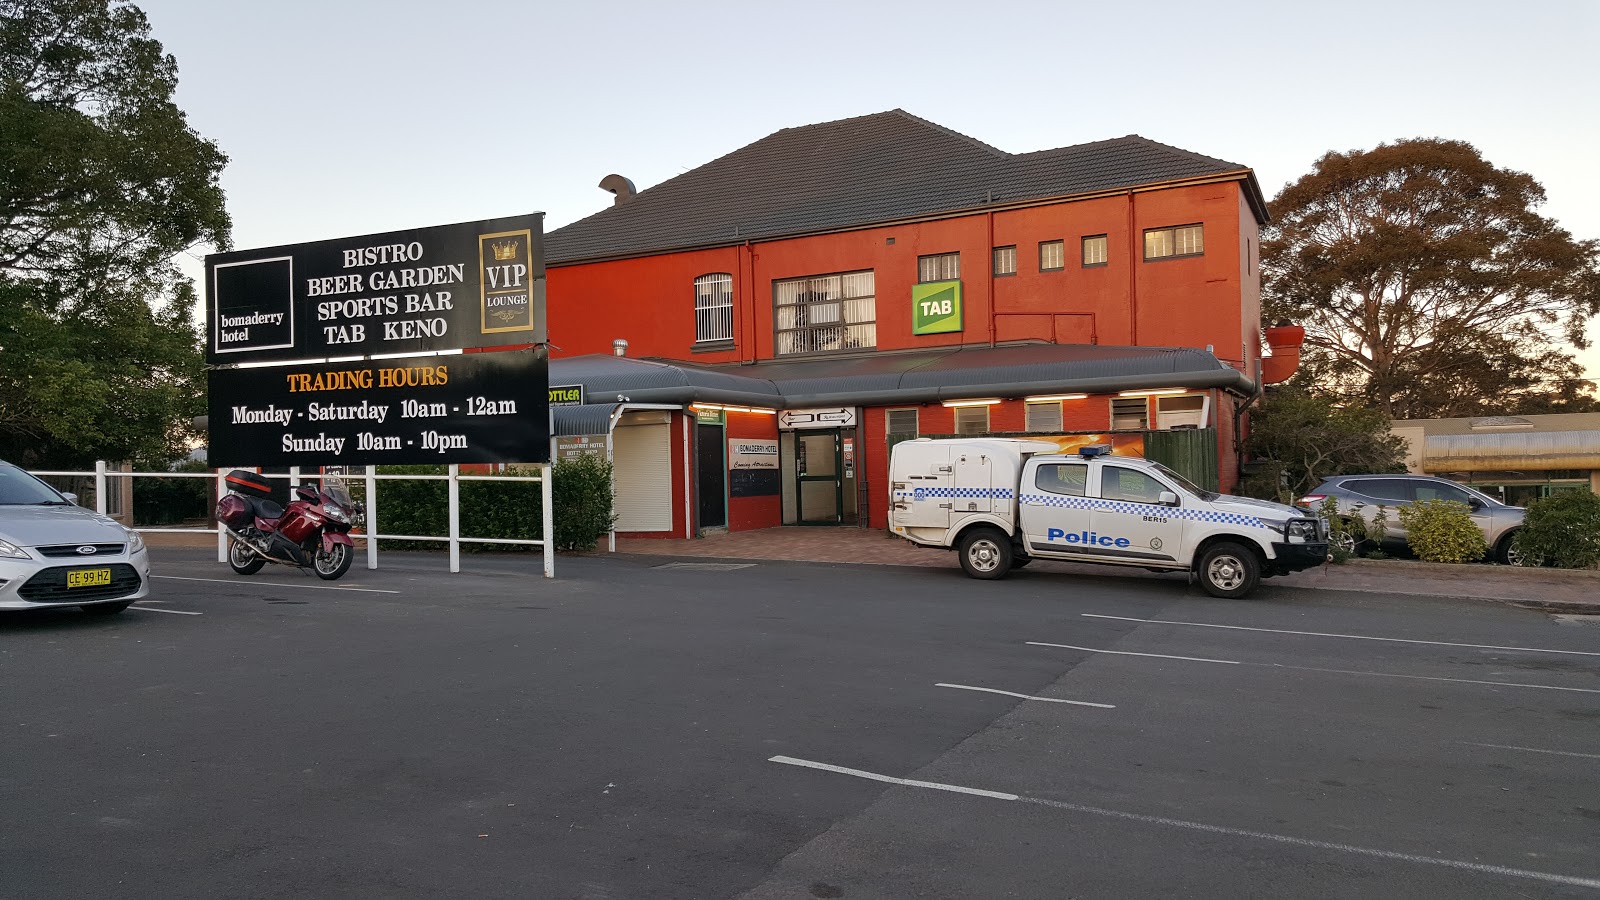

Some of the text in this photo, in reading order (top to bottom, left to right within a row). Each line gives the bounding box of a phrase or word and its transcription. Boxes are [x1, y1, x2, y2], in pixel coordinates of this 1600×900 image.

[343, 241, 423, 269] BISTRO
[307, 263, 465, 297] BEER GARDEN
[486, 263, 527, 289] VIP
[317, 291, 454, 321] SPORTS BAR
[487, 295, 527, 307] LOUNGE
[921, 300, 952, 317] TAB
[221, 311, 284, 328] bomaderry
[323, 317, 448, 345] TAB KENO
[221, 327, 249, 343] hotel
[287, 365, 448, 393] TRADING HOURS
[232, 405, 293, 427] Monday
[308, 400, 389, 424] Saturday
[401, 399, 447, 419] 10am
[466, 396, 517, 416] 12am
[282, 432, 346, 455] Sunday
[356, 431, 402, 450] 10am
[420, 430, 468, 453] 10pm
[765, 445, 777, 453] HOTEL
[1142, 515, 1168, 524] BER15
[1047, 527, 1131, 548] Police
[70, 570, 109, 583] CE 99 HZ
